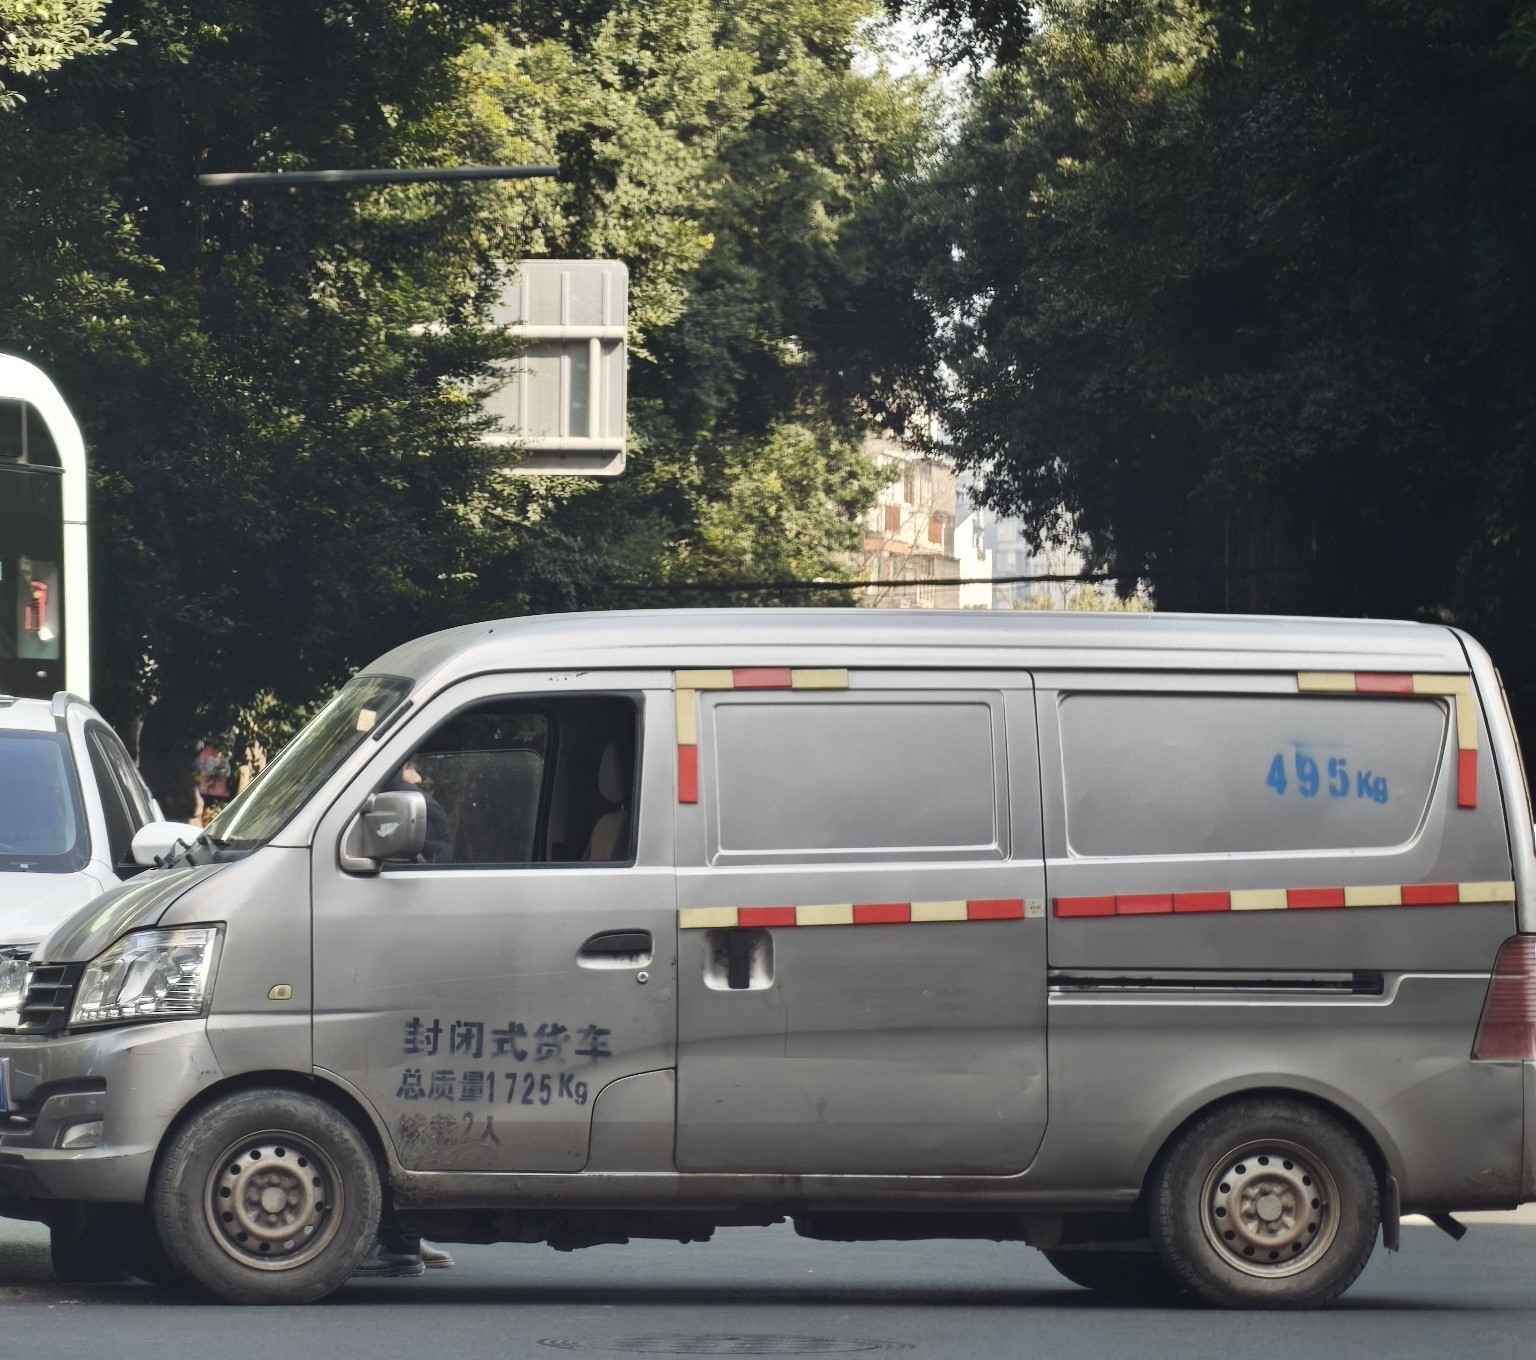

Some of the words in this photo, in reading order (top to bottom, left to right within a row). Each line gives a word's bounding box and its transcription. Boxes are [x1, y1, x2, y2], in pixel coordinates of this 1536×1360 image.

[402, 1017, 612, 1064] 封闭式货车
